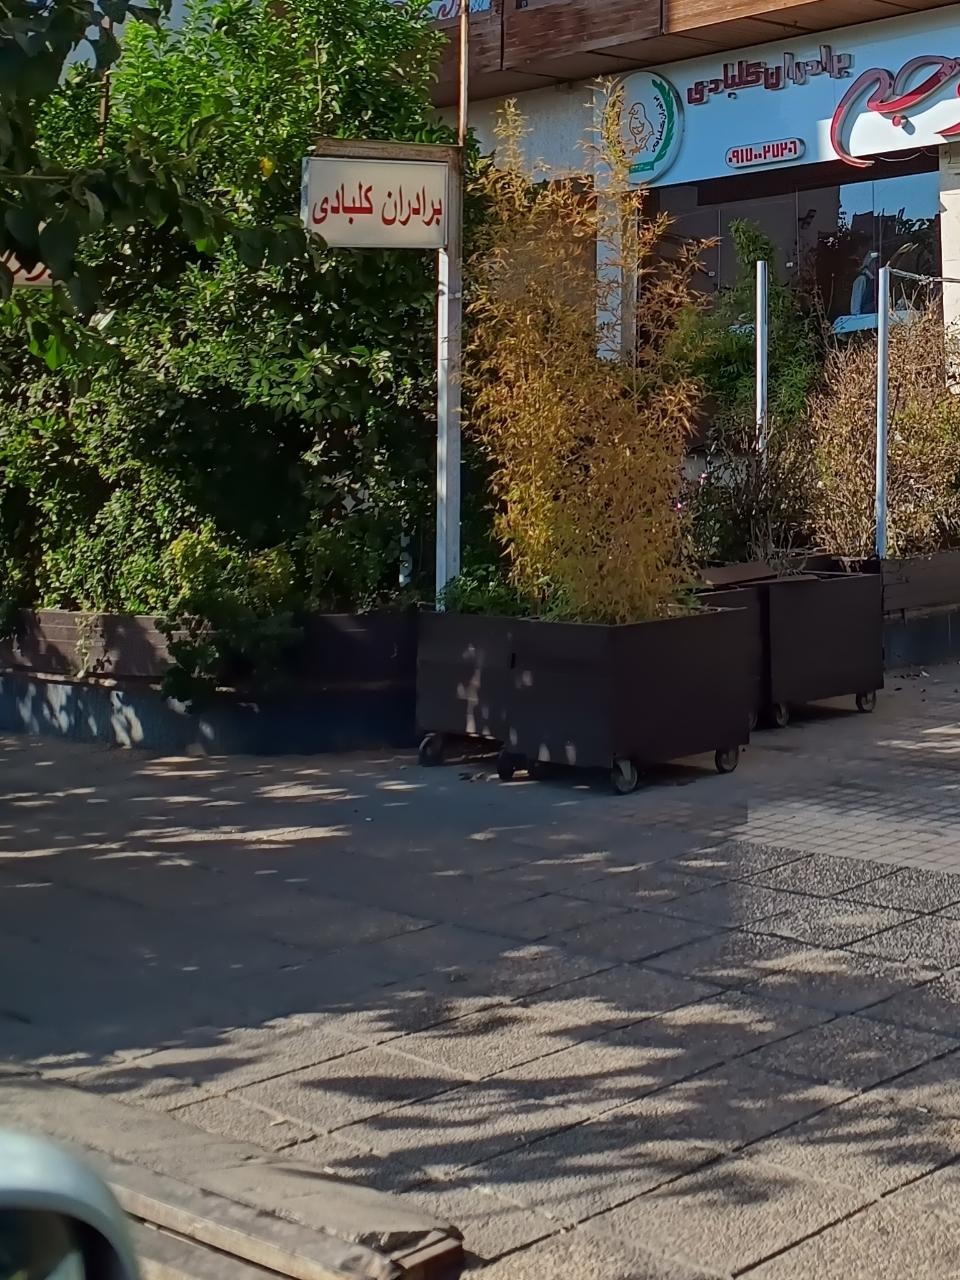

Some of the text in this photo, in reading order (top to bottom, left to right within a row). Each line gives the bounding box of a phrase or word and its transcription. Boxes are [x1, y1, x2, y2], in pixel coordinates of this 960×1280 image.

[687, 44, 852, 106] برادران کلبادی
[312, 180, 444, 227] برادران کلبادی
